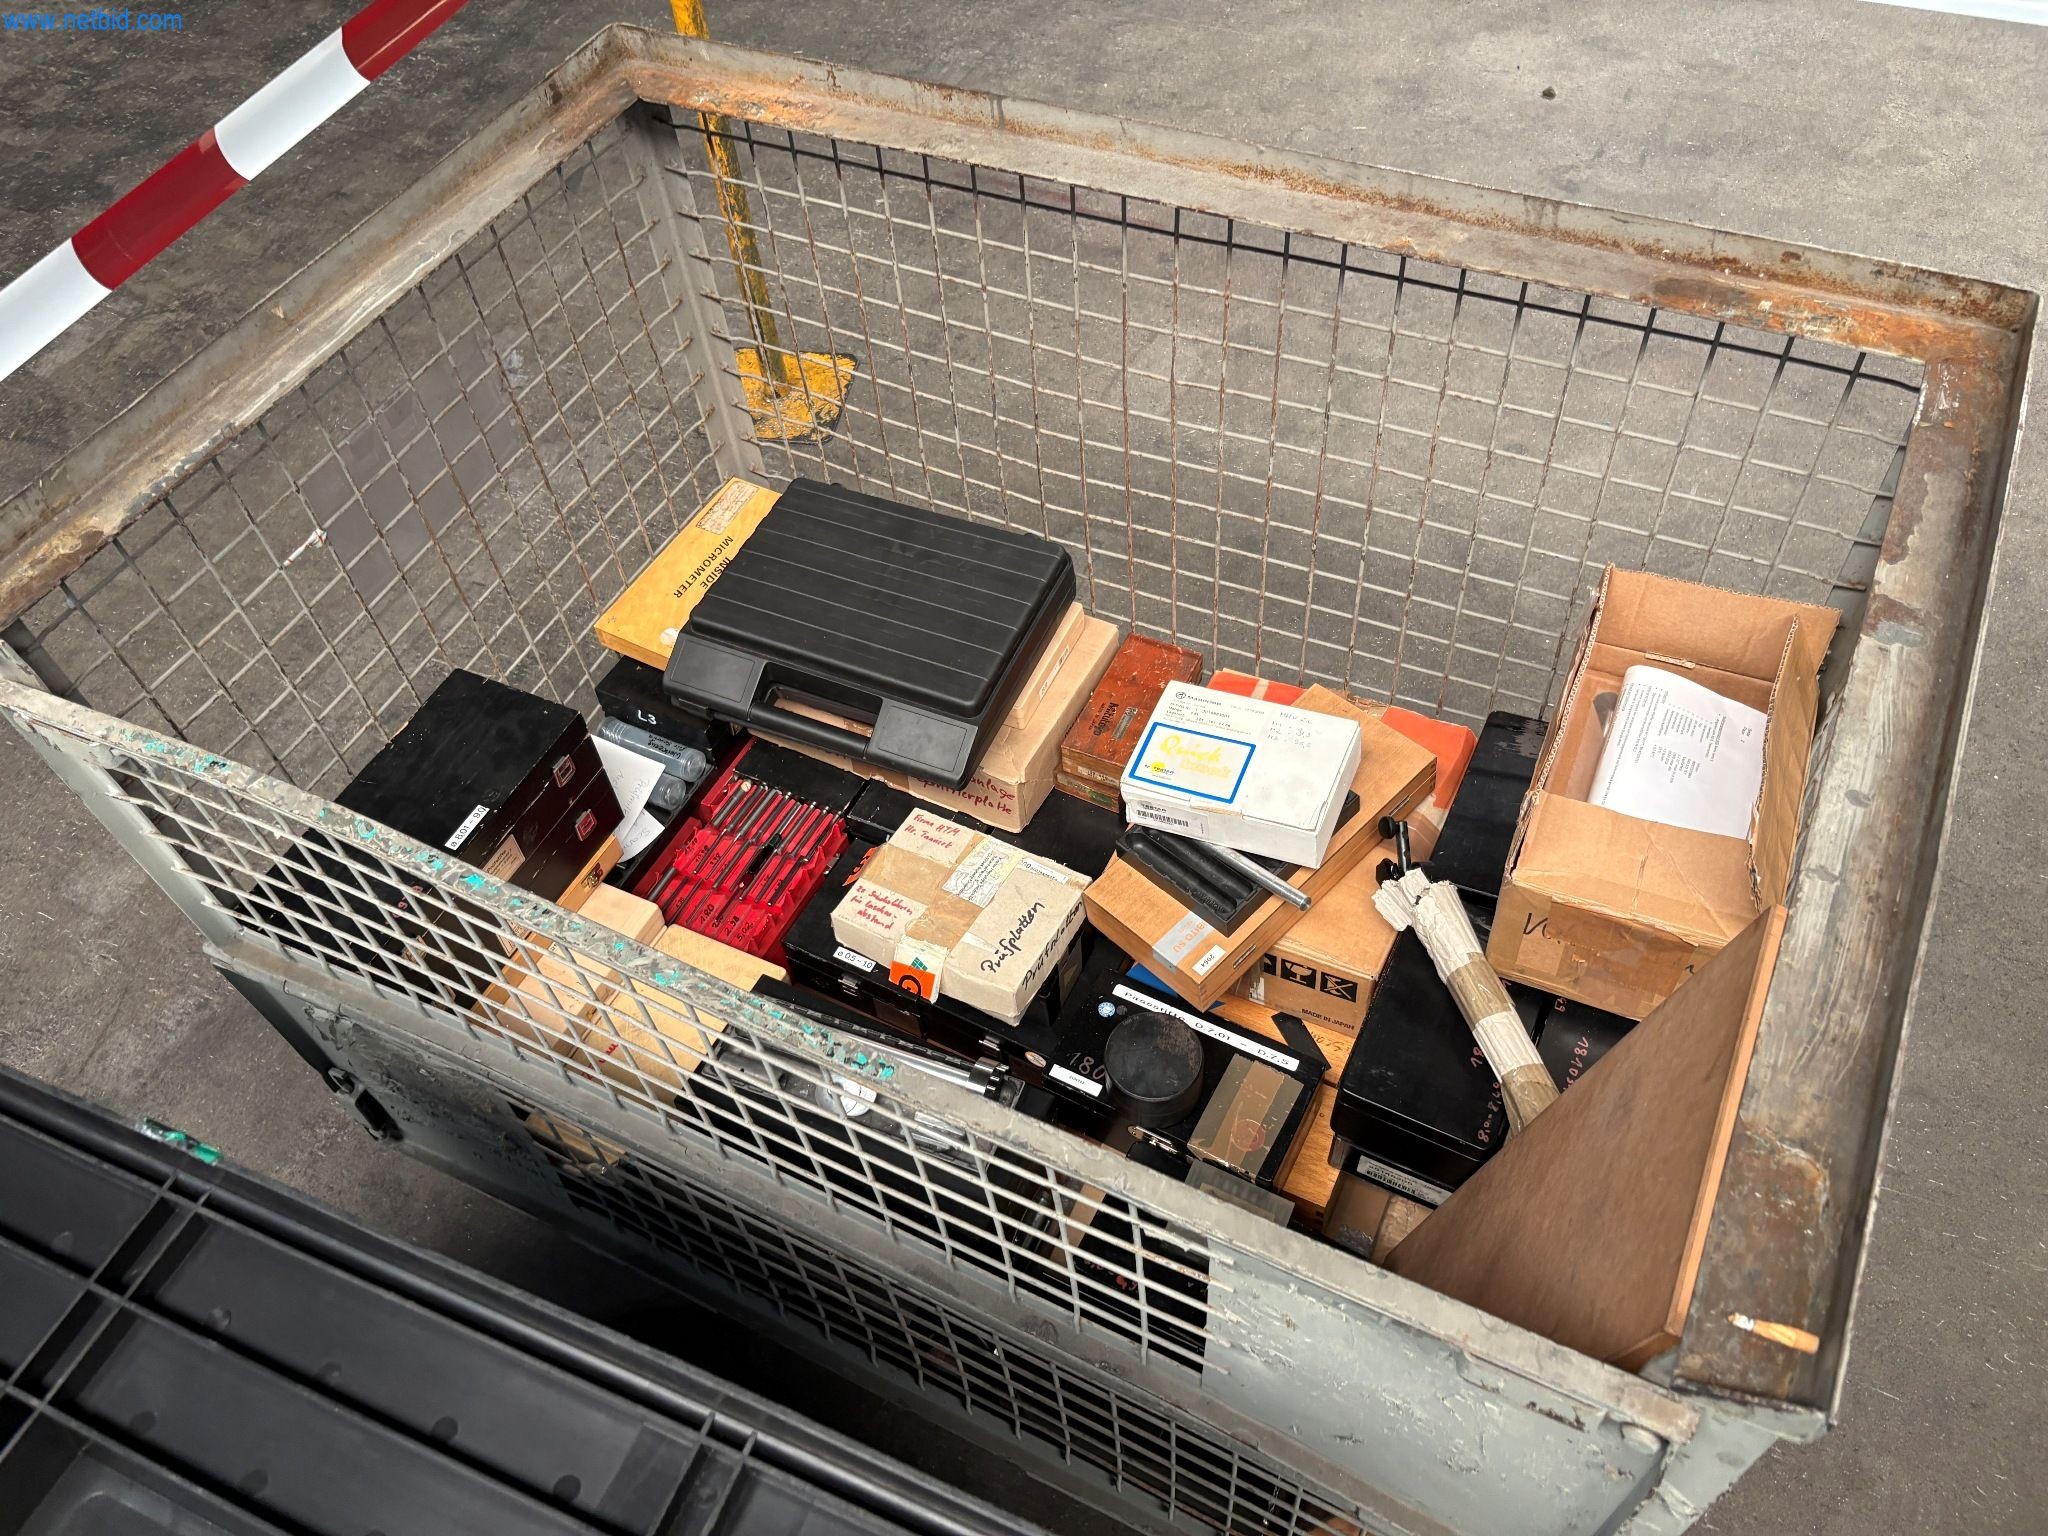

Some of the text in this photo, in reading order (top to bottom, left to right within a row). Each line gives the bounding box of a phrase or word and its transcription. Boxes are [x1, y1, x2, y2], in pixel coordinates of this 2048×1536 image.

[673, 535, 734, 599] MICROMETER
[700, 556, 731, 590] INSIDE
[637, 709, 657, 725] L3
[980, 901, 1046, 974] Prüfplatten
[1301, 1008, 1355, 1031] MADE IN JAPAN
